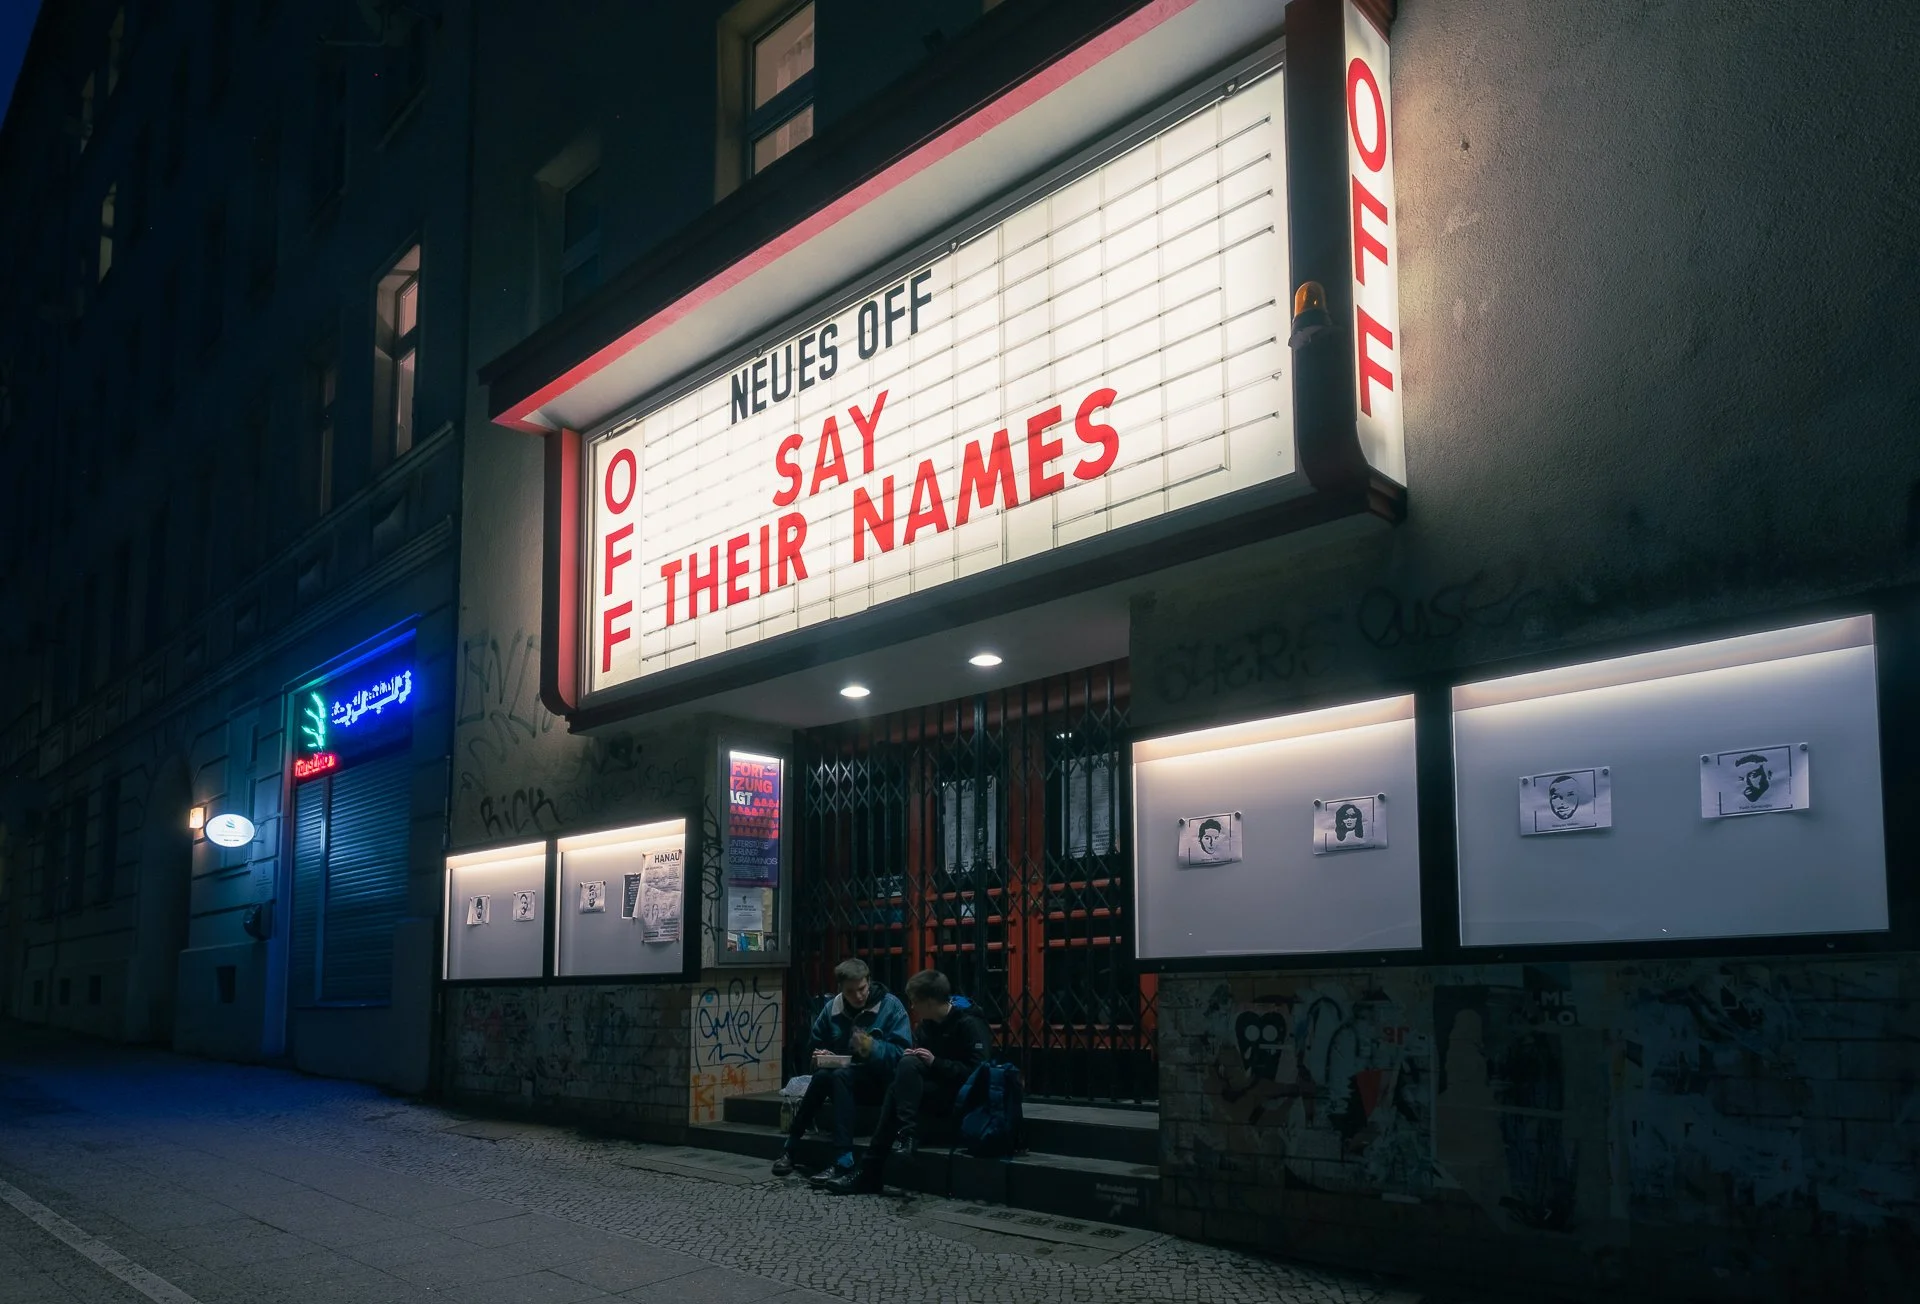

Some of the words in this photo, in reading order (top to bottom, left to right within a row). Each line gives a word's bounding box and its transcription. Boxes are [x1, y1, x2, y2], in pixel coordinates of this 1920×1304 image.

[1346, 58, 1393, 417] OFF
[731, 324, 838, 424] NEUES
[857, 269, 932, 360] OFF
[660, 512, 808, 626] THEIR
[854, 388, 1119, 562] NAMES
[773, 390, 888, 506] SAY
[602, 448, 637, 673] OFF
[654, 852, 681, 864] HANAU
